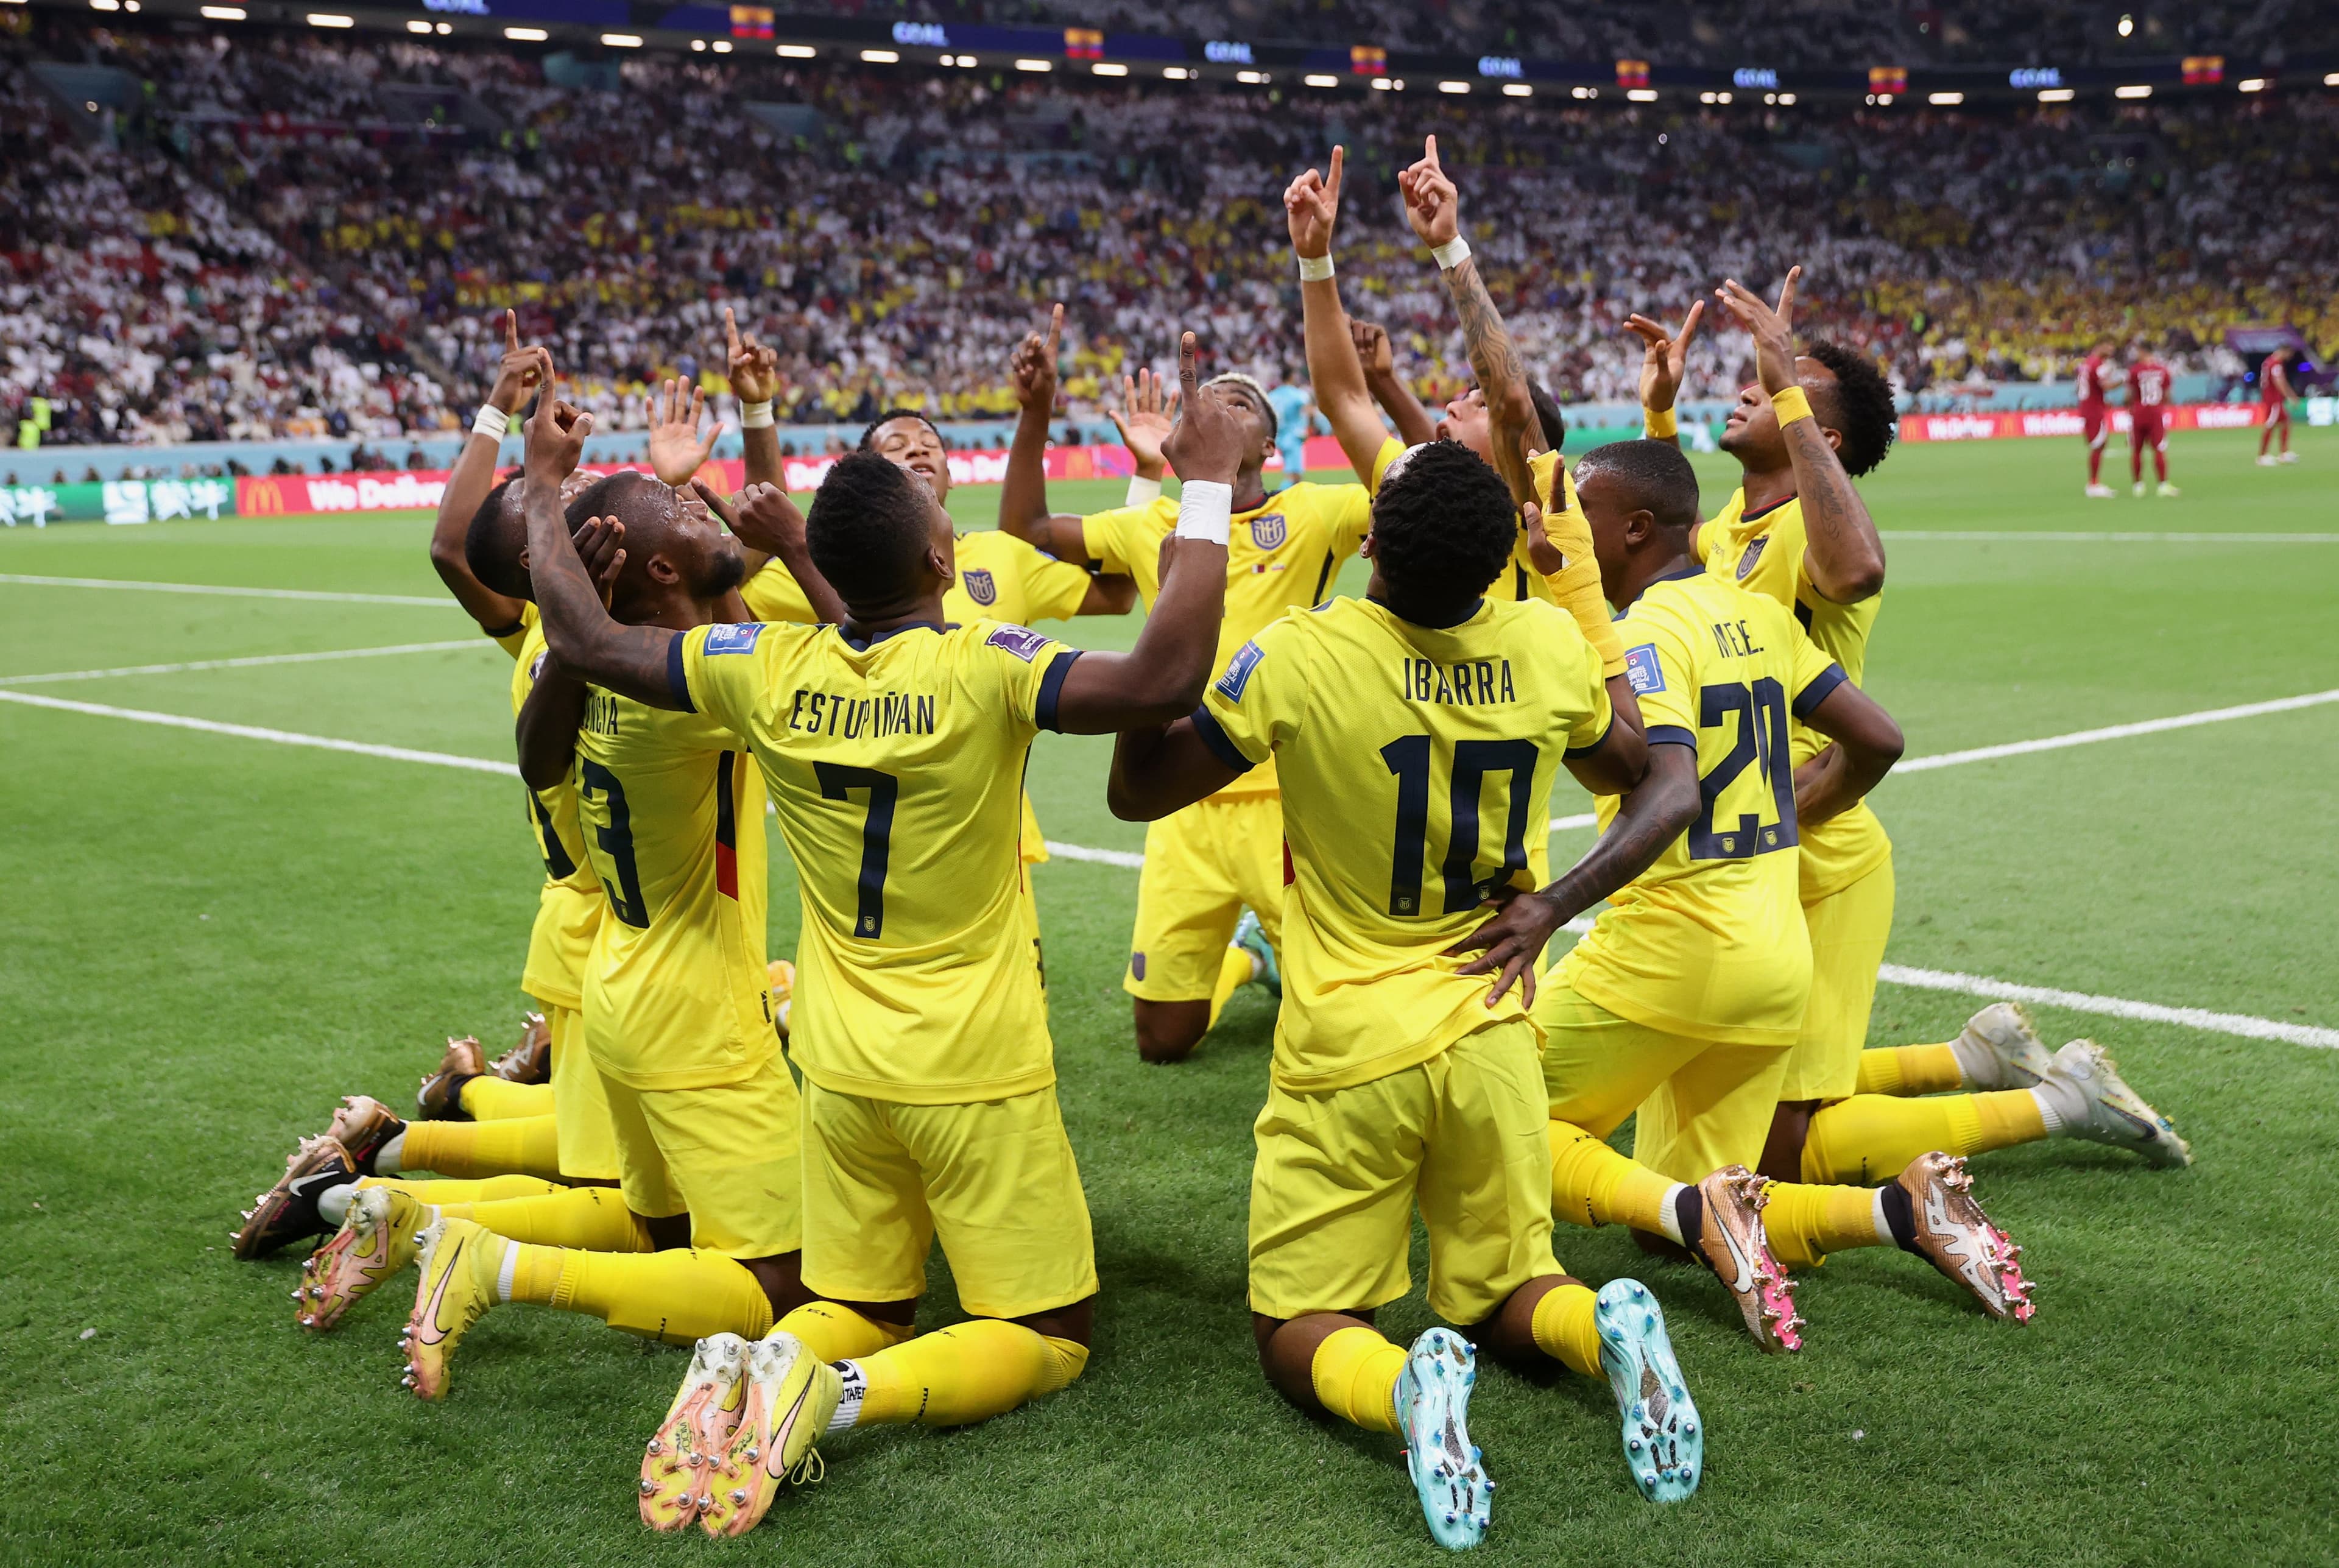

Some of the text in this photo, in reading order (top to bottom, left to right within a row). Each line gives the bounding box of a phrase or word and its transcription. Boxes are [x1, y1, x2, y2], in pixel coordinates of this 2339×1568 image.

[1403, 657, 1516, 707] IBARRA
[812, 760, 898, 939] 7
[1379, 734, 1539, 916] 10
